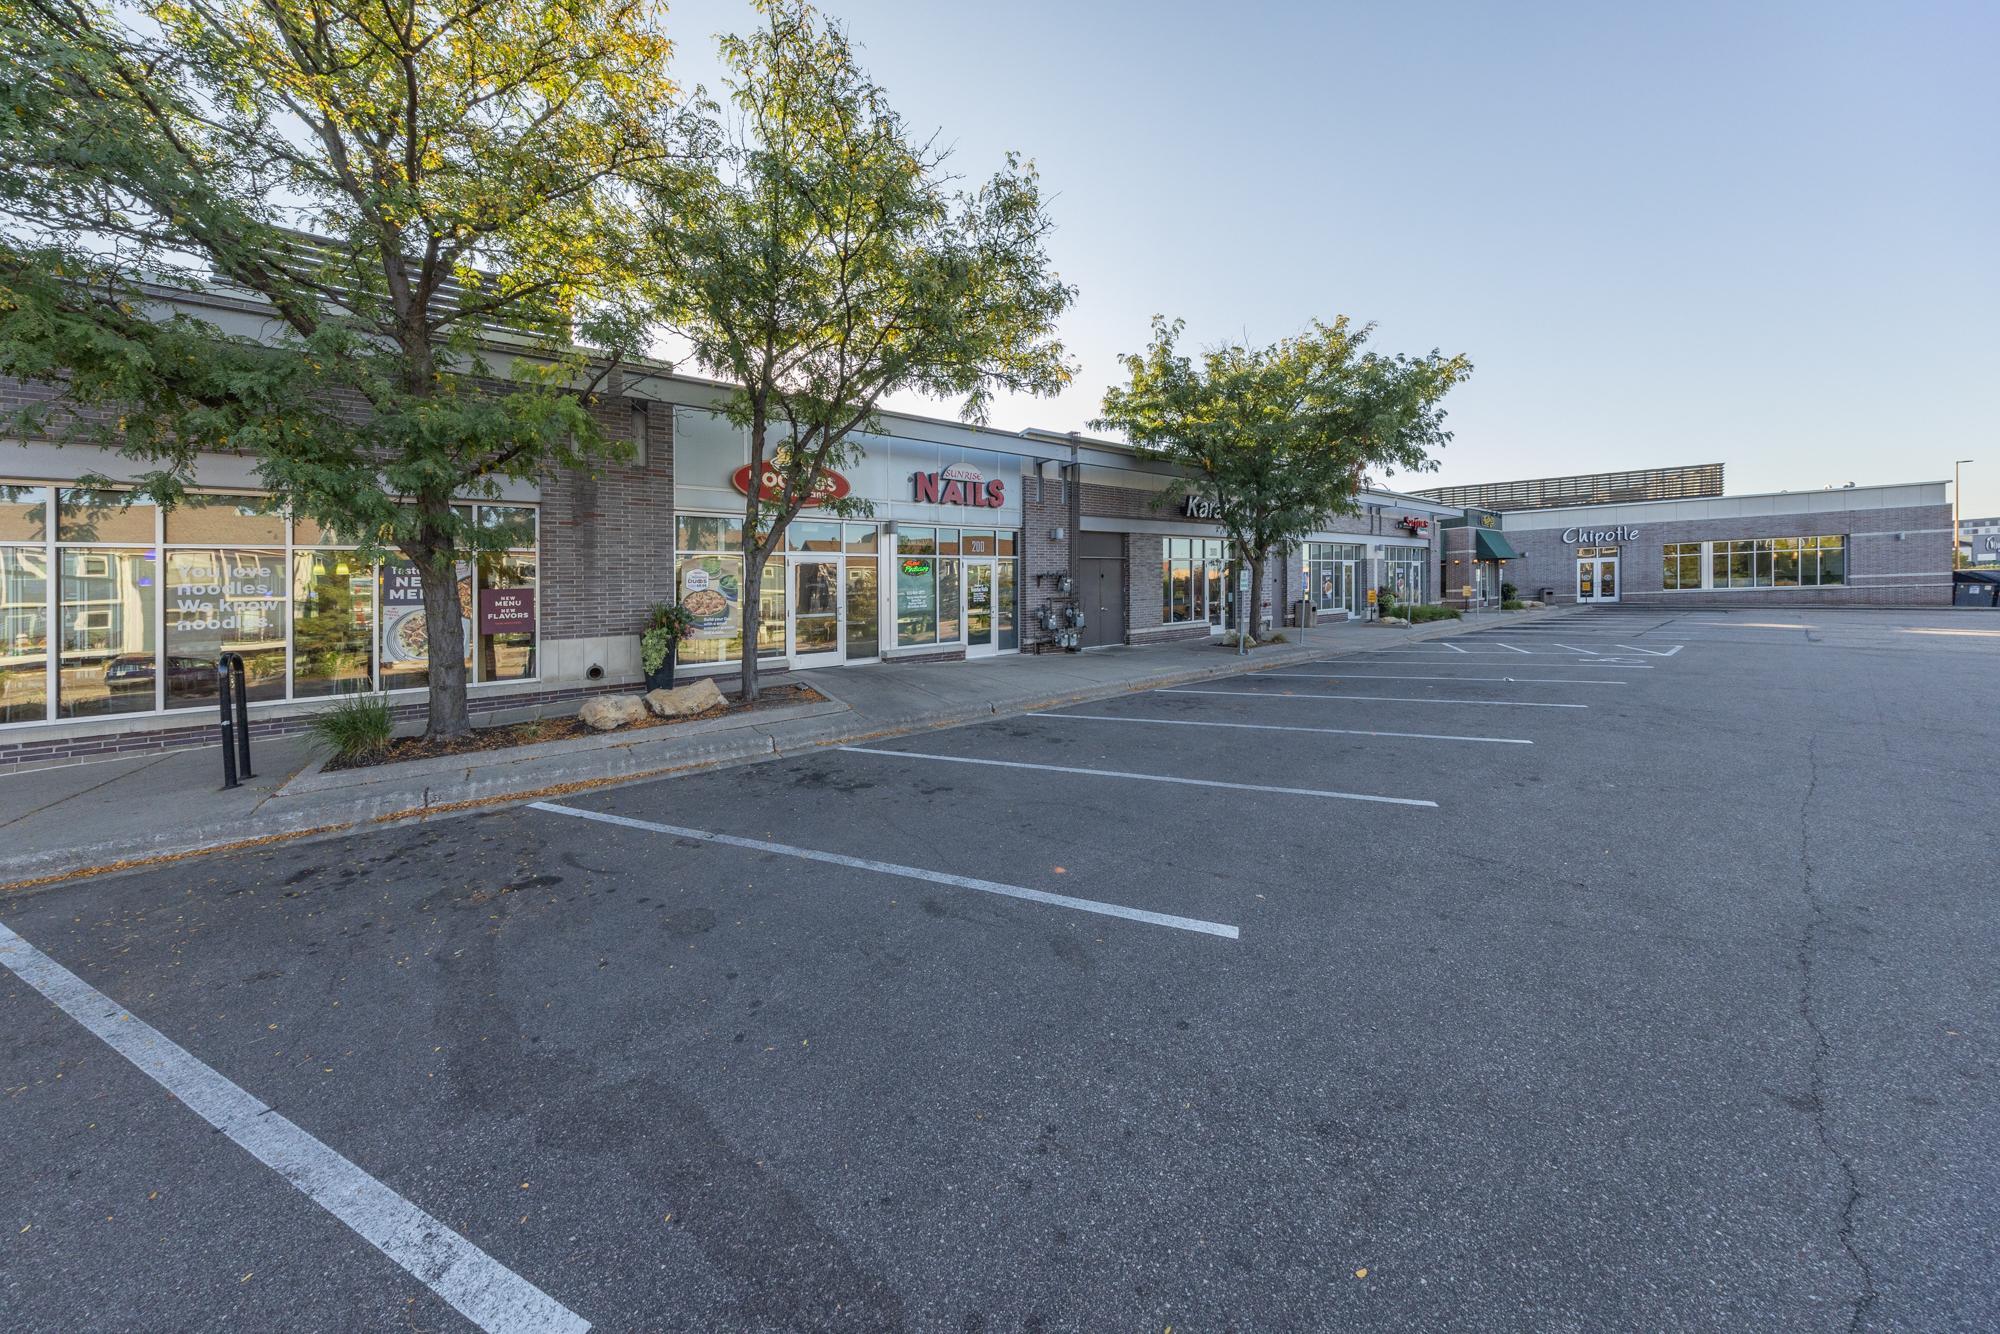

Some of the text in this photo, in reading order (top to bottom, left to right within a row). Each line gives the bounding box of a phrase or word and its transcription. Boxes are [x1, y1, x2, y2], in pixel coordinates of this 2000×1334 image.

[945, 469, 983, 481] SUNRISE
[915, 471, 1005, 508] NAILS
[1186, 495, 1229, 518] Kara
[1562, 526, 1640, 546] Chipotle
[971, 540, 985, 552] 200
[177, 563, 271, 578] You love
[177, 581, 273, 596] noodles.
[395, 576, 422, 587] NE
[389, 589, 424, 600] ME
[177, 598, 279, 613] We know
[487, 612, 529, 620] FLAVORS
